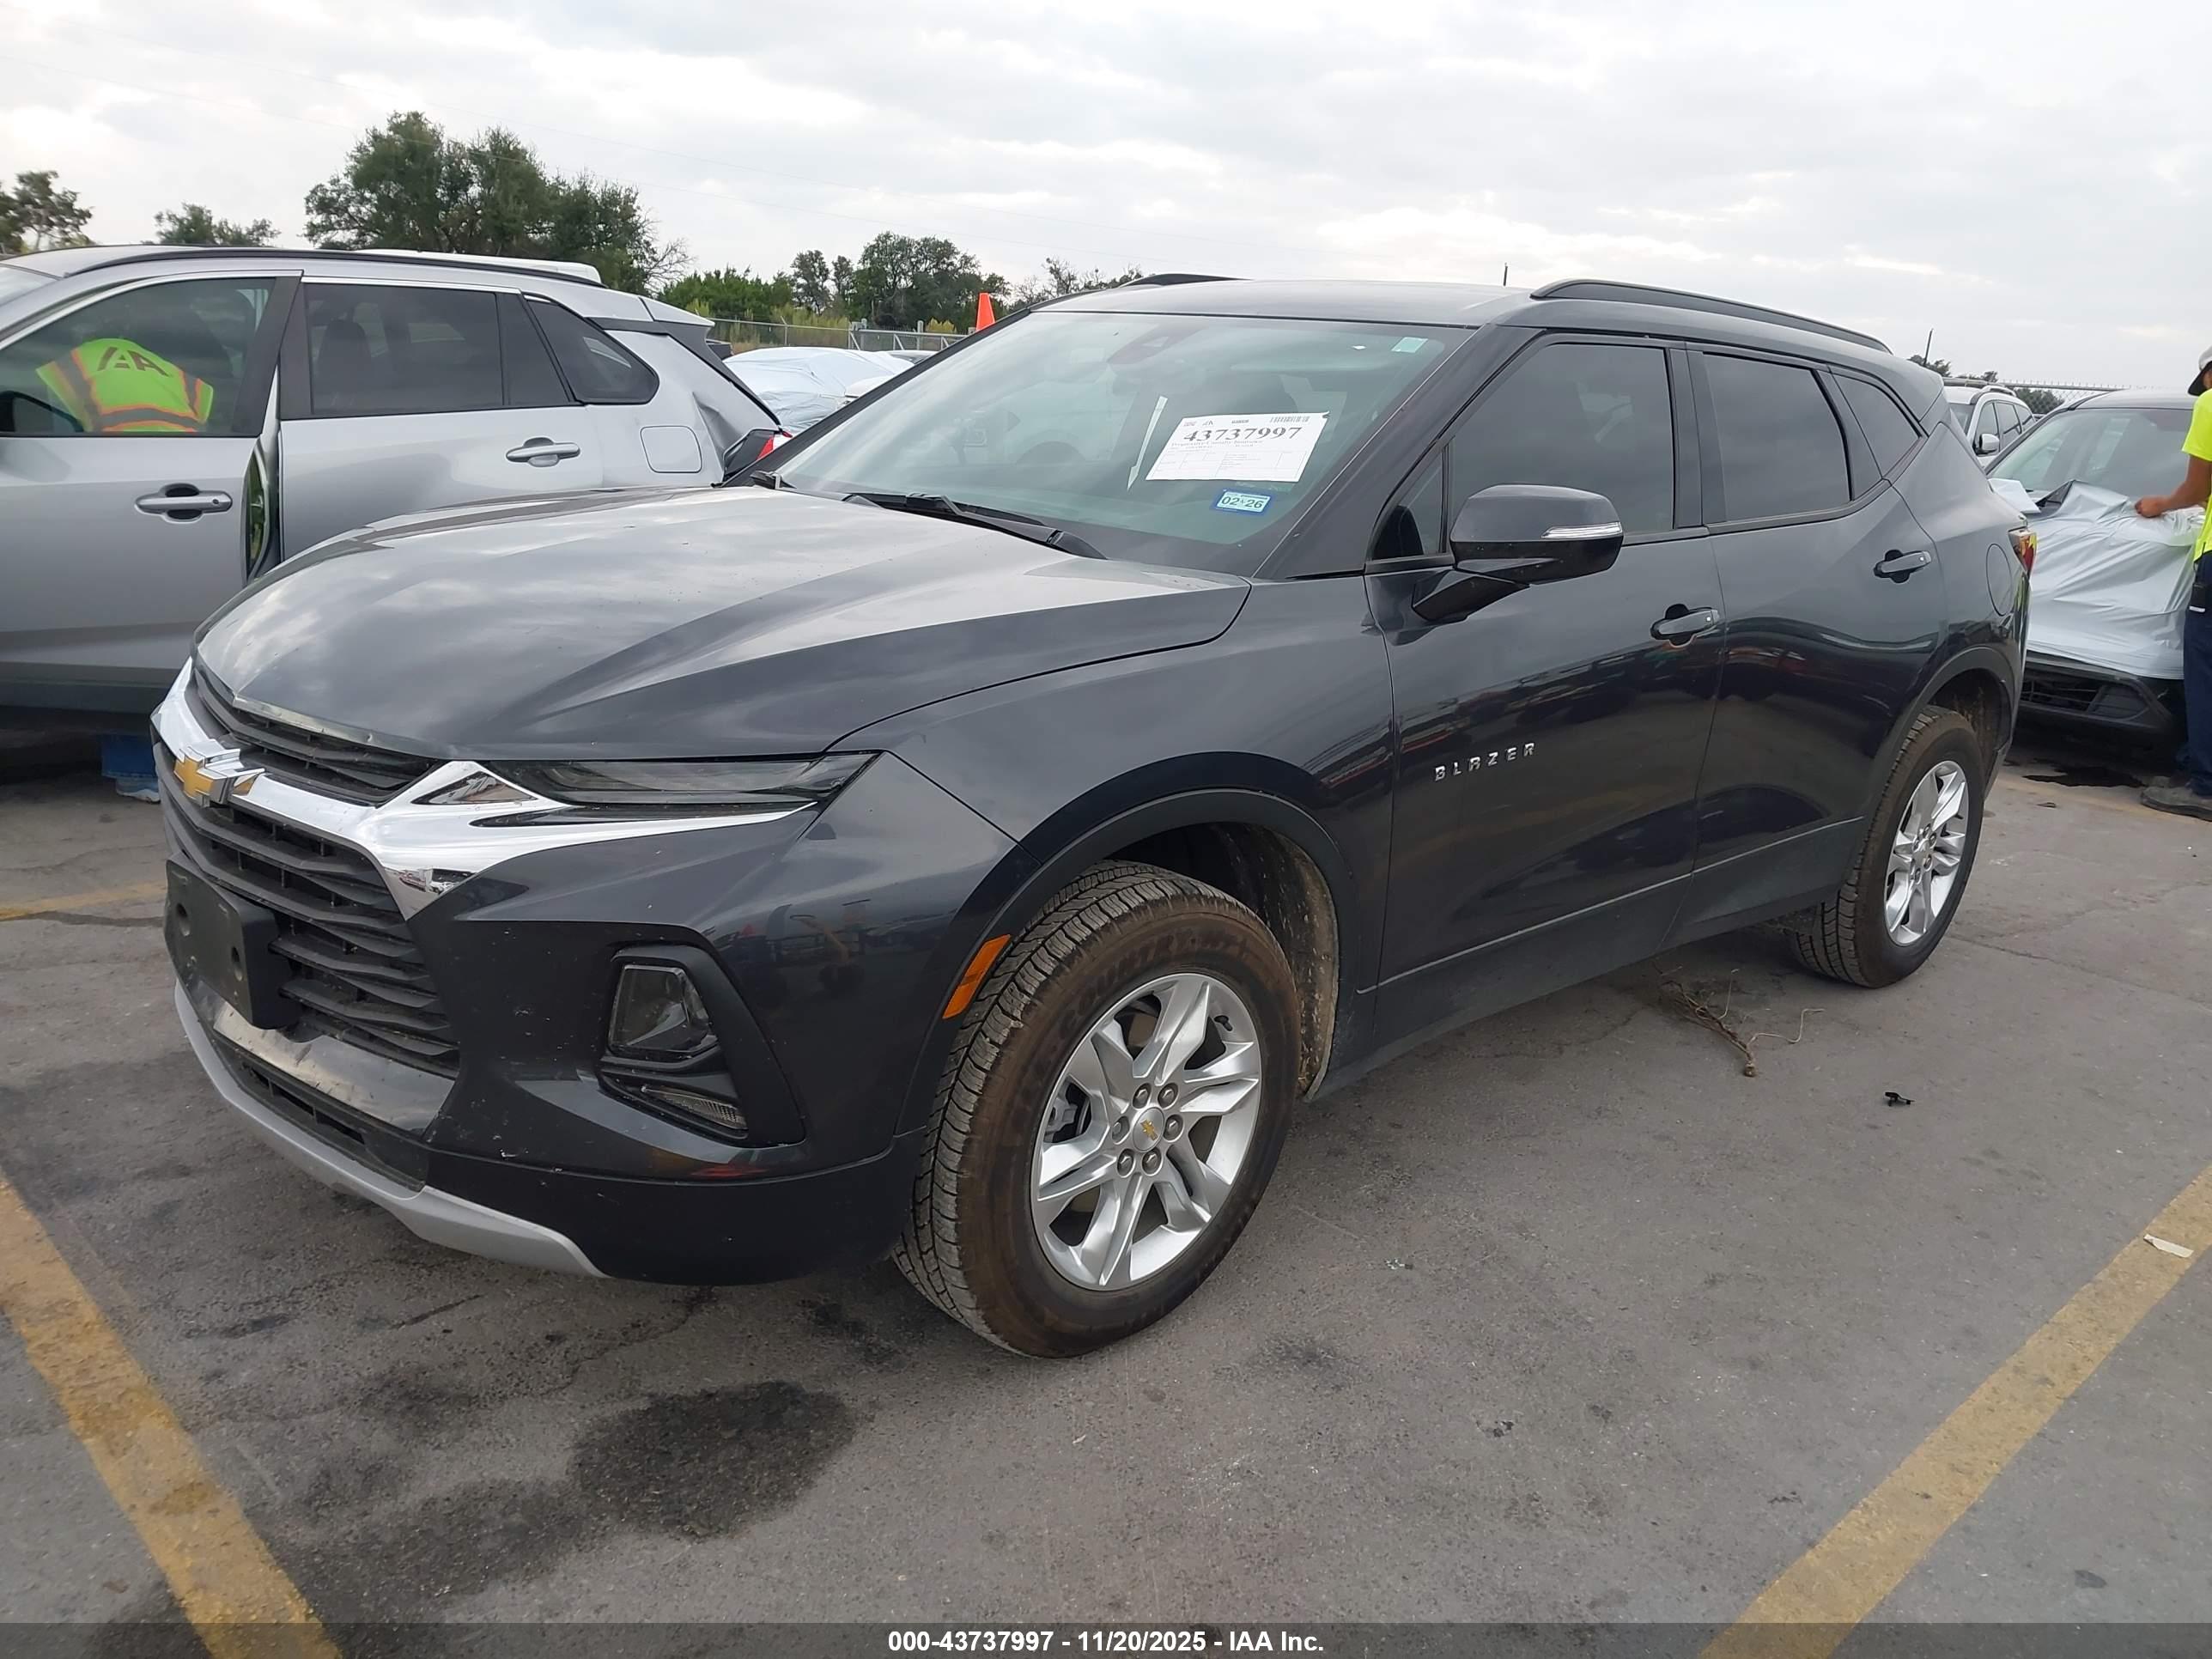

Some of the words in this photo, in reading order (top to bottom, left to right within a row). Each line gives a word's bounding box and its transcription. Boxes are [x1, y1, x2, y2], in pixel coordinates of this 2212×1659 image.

[1183, 427, 1303, 441] 43737997
[1221, 496, 1240, 506] 02
[1244, 499, 1264, 508] 26
[1434, 742, 1535, 781] BLAZER
